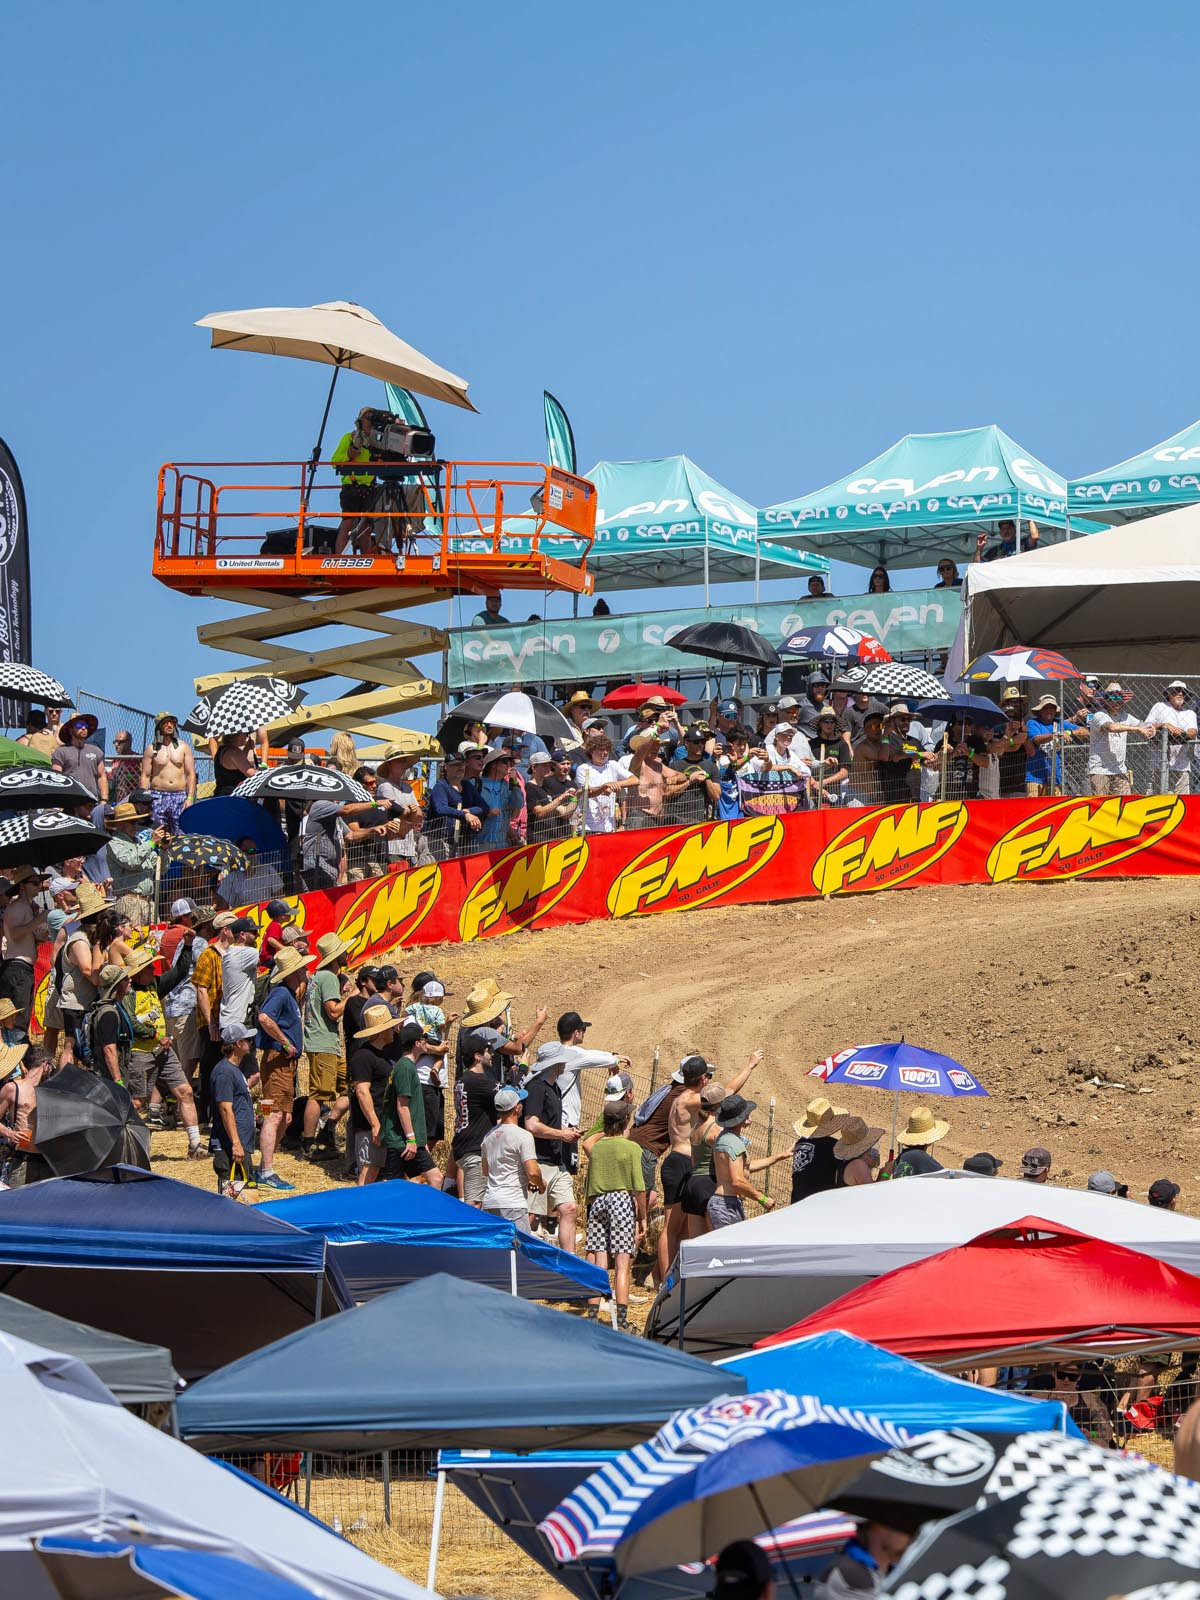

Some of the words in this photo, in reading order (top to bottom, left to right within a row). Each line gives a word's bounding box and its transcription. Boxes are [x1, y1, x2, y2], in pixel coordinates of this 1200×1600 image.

[1, 767, 67, 785] GUTS
[271, 769, 338, 787] GUTS
[612, 814, 777, 920] FMF
[822, 800, 964, 895] FMF
[993, 794, 1180, 883] FMF
[462, 836, 585, 942] FMF
[849, 1063, 883, 1078] 100%
[903, 1070, 936, 1084] 100%
